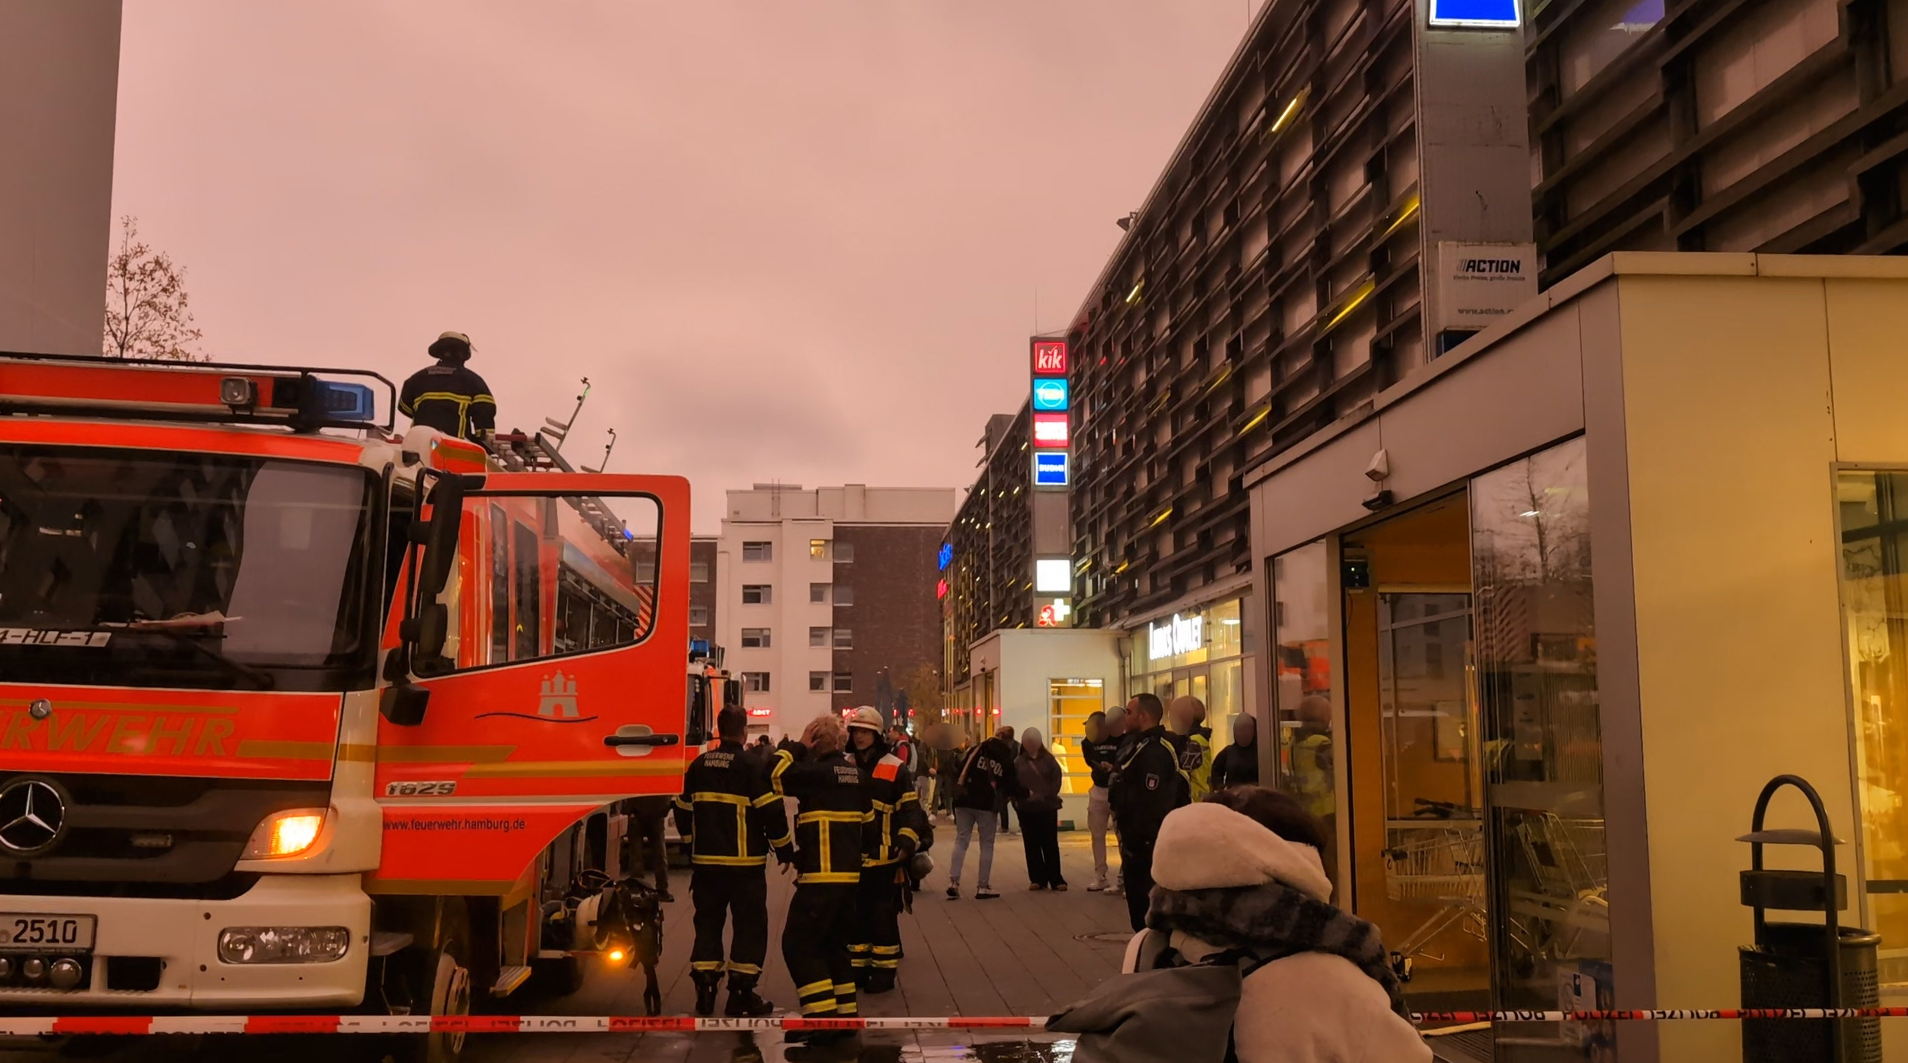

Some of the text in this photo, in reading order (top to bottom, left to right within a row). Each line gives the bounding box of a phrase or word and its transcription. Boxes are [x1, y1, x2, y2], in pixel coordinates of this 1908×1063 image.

[1465, 259, 1521, 274] ACTION
[383, 819, 525, 833] www.feuerwehr.hamburg.de
[13, 919, 77, 943] 2510
